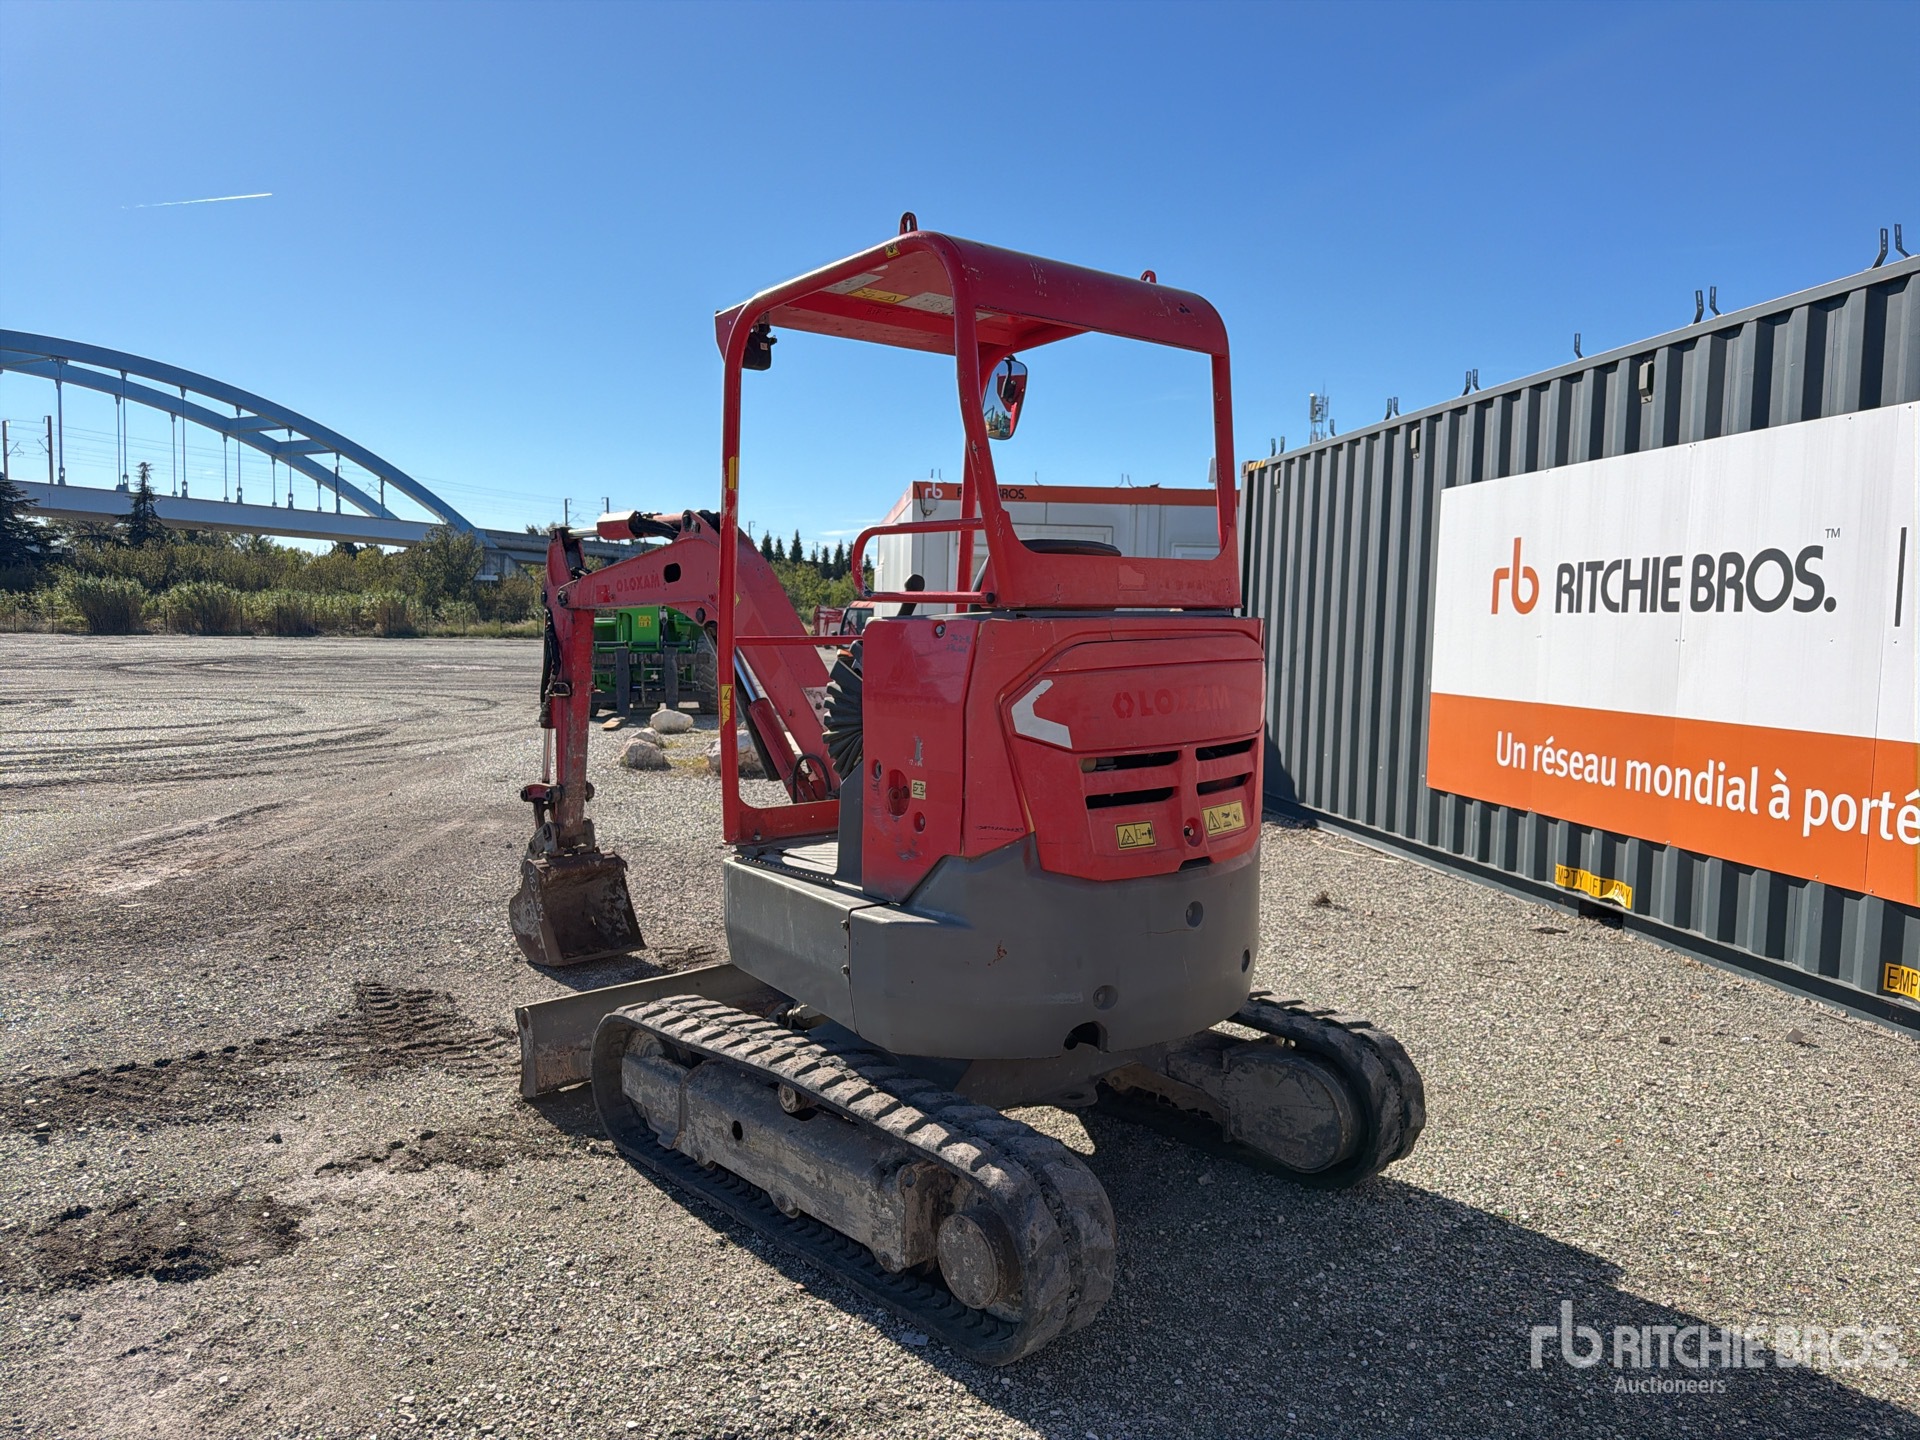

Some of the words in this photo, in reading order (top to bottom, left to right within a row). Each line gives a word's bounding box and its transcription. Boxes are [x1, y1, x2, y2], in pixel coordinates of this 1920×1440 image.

[1491, 537, 1540, 614] rb
[1554, 555, 1684, 613] RITCHIE
[1690, 545, 1837, 613] BROS.
[1496, 730, 1526, 769] Un
[1533, 735, 1617, 787] réseau
[1625, 759, 1759, 815] mondial
[1768, 768, 1791, 821] à
[1555, 866, 1585, 888] MPTY
[1887, 966, 1920, 995] EMP
